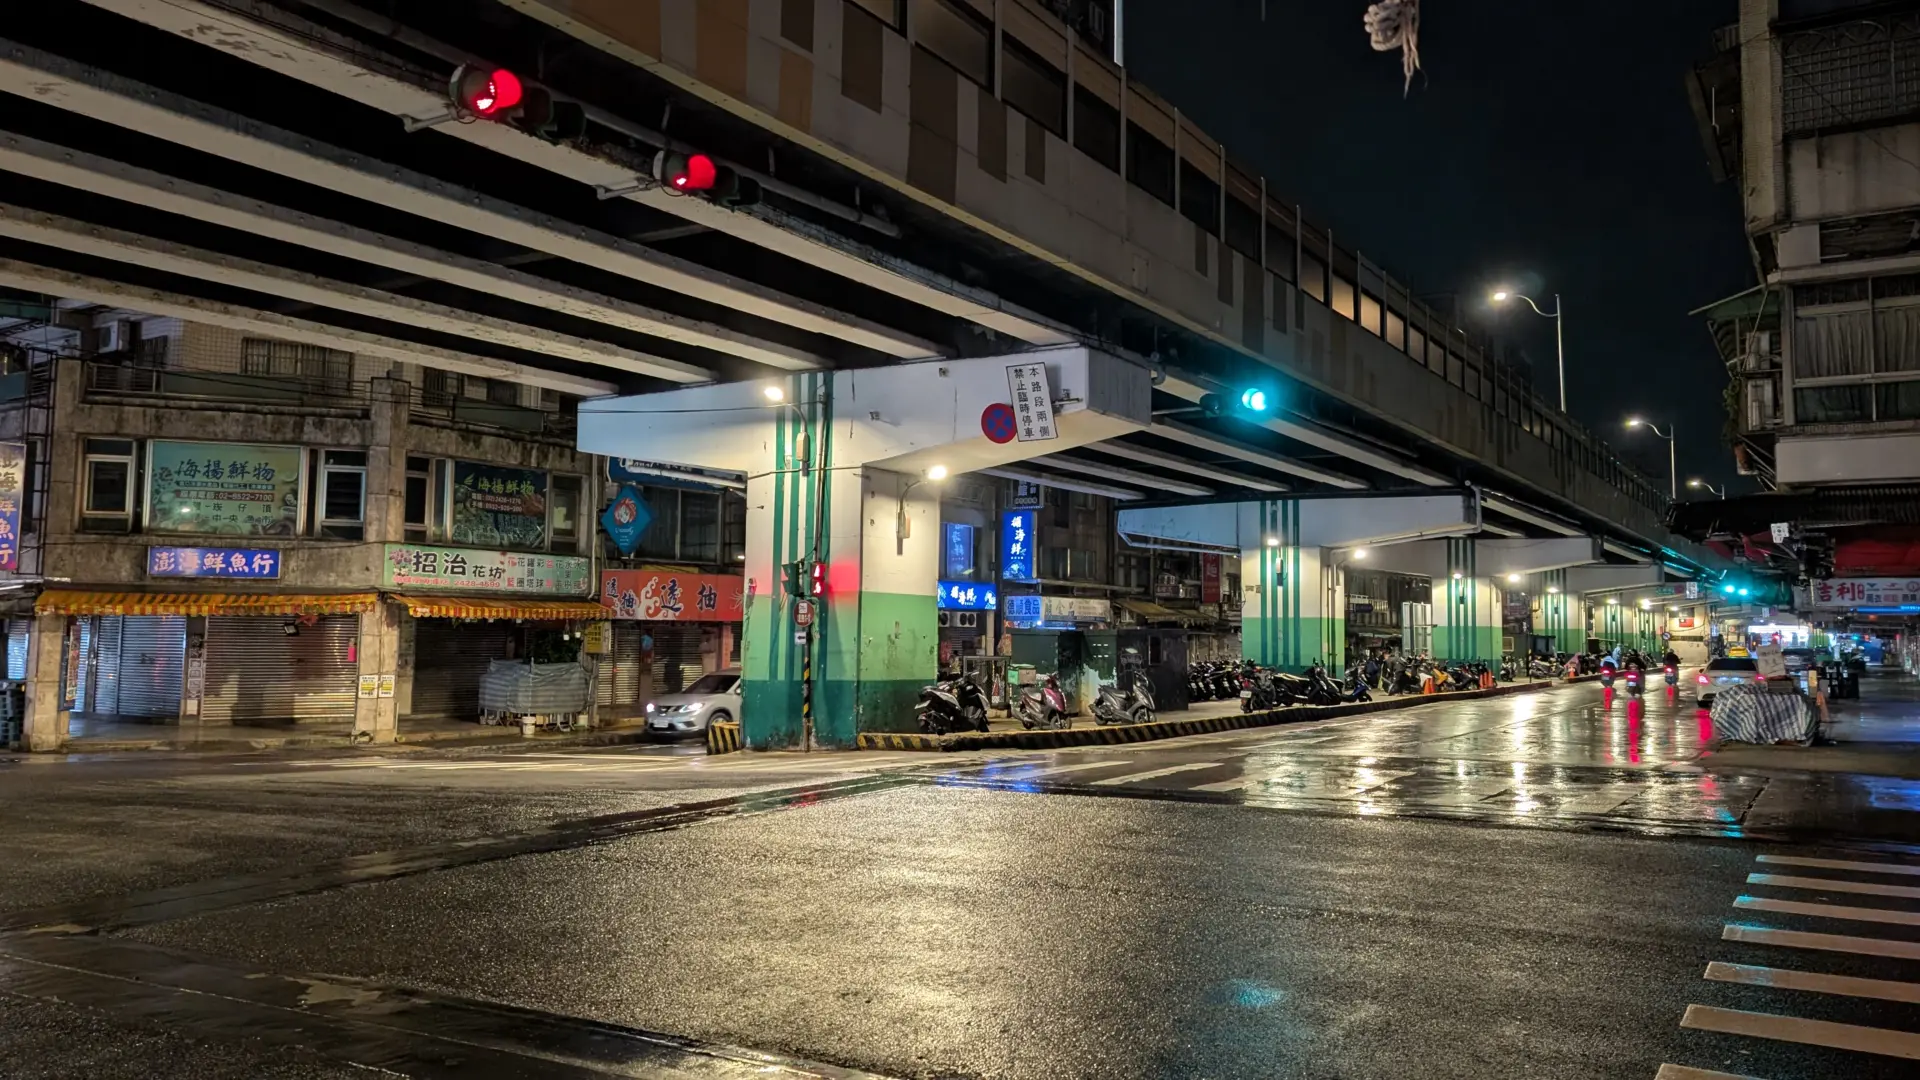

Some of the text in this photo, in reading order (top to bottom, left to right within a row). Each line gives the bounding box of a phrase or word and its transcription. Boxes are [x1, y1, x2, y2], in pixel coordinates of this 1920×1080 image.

[1014, 368, 1035, 438] 禁止臨時停車
[1029, 367, 1049, 437] 本路段兩側
[174, 459, 276, 481] 海揚鮮物
[154, 552, 274, 574] 澎海鮮魚行
[606, 579, 635, 609] 透抽
[660, 579, 718, 612] 透抽
[1818, 582, 1856, 601] 吉利
